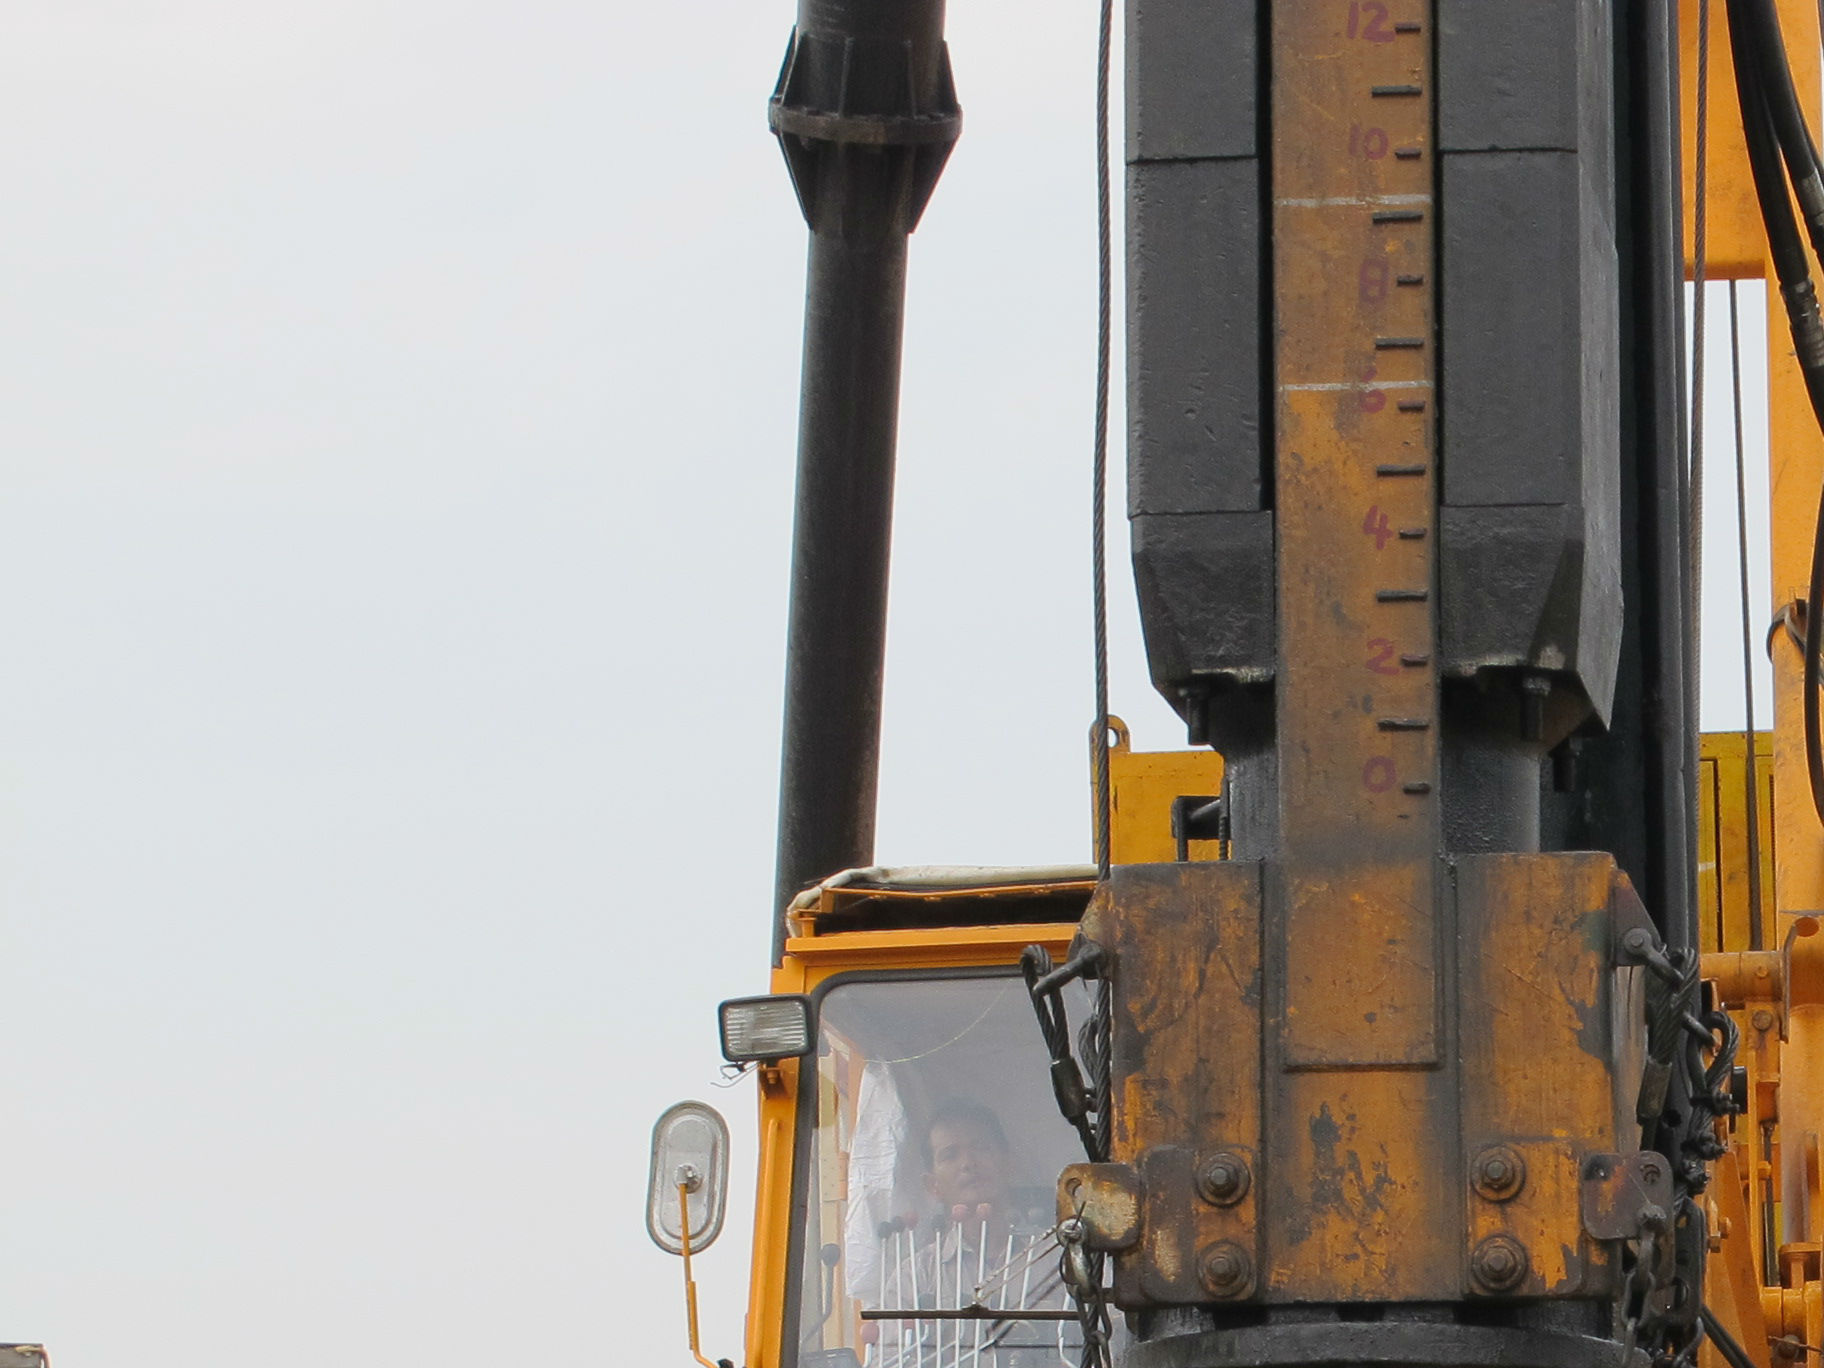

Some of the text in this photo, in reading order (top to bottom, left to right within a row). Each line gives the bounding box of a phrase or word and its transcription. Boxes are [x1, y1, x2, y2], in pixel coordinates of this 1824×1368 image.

[1347, 1, 1396, 43] 12
[1350, 124, 1389, 160] 10
[1359, 258, 1389, 302] 8
[1363, 505, 1393, 549] 4
[1366, 637, 1400, 675] 2
[1362, 755, 1397, 793] 0
